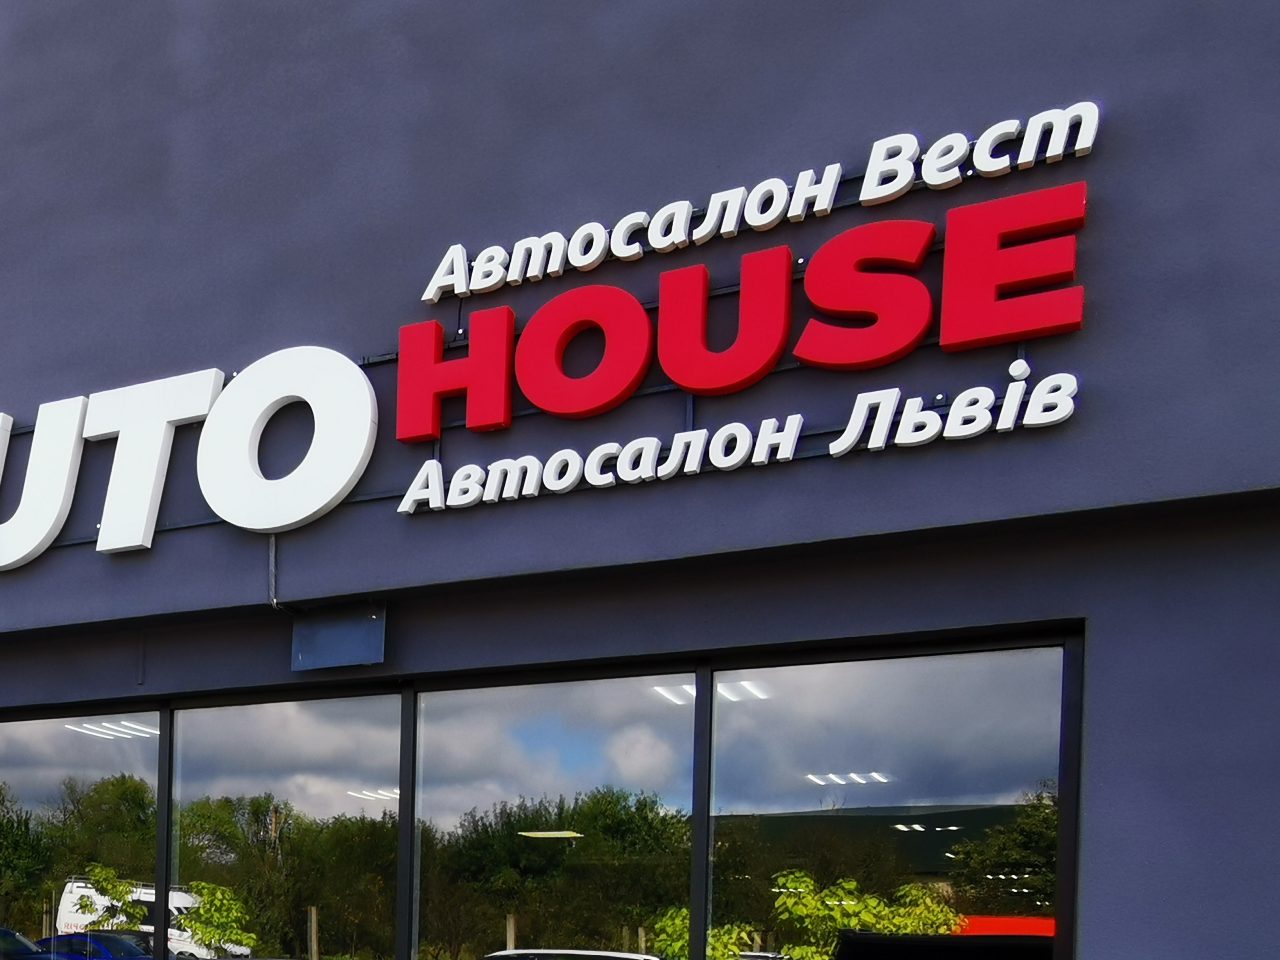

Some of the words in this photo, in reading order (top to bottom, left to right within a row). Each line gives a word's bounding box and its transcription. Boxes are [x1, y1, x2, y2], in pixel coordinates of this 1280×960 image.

[421, 163, 843, 303] Автосалон
[859, 101, 1100, 205] Вест
[396, 180, 1087, 442] HOUSE
[399, 413, 803, 514] Автосалон
[829, 359, 1078, 458] Львів
